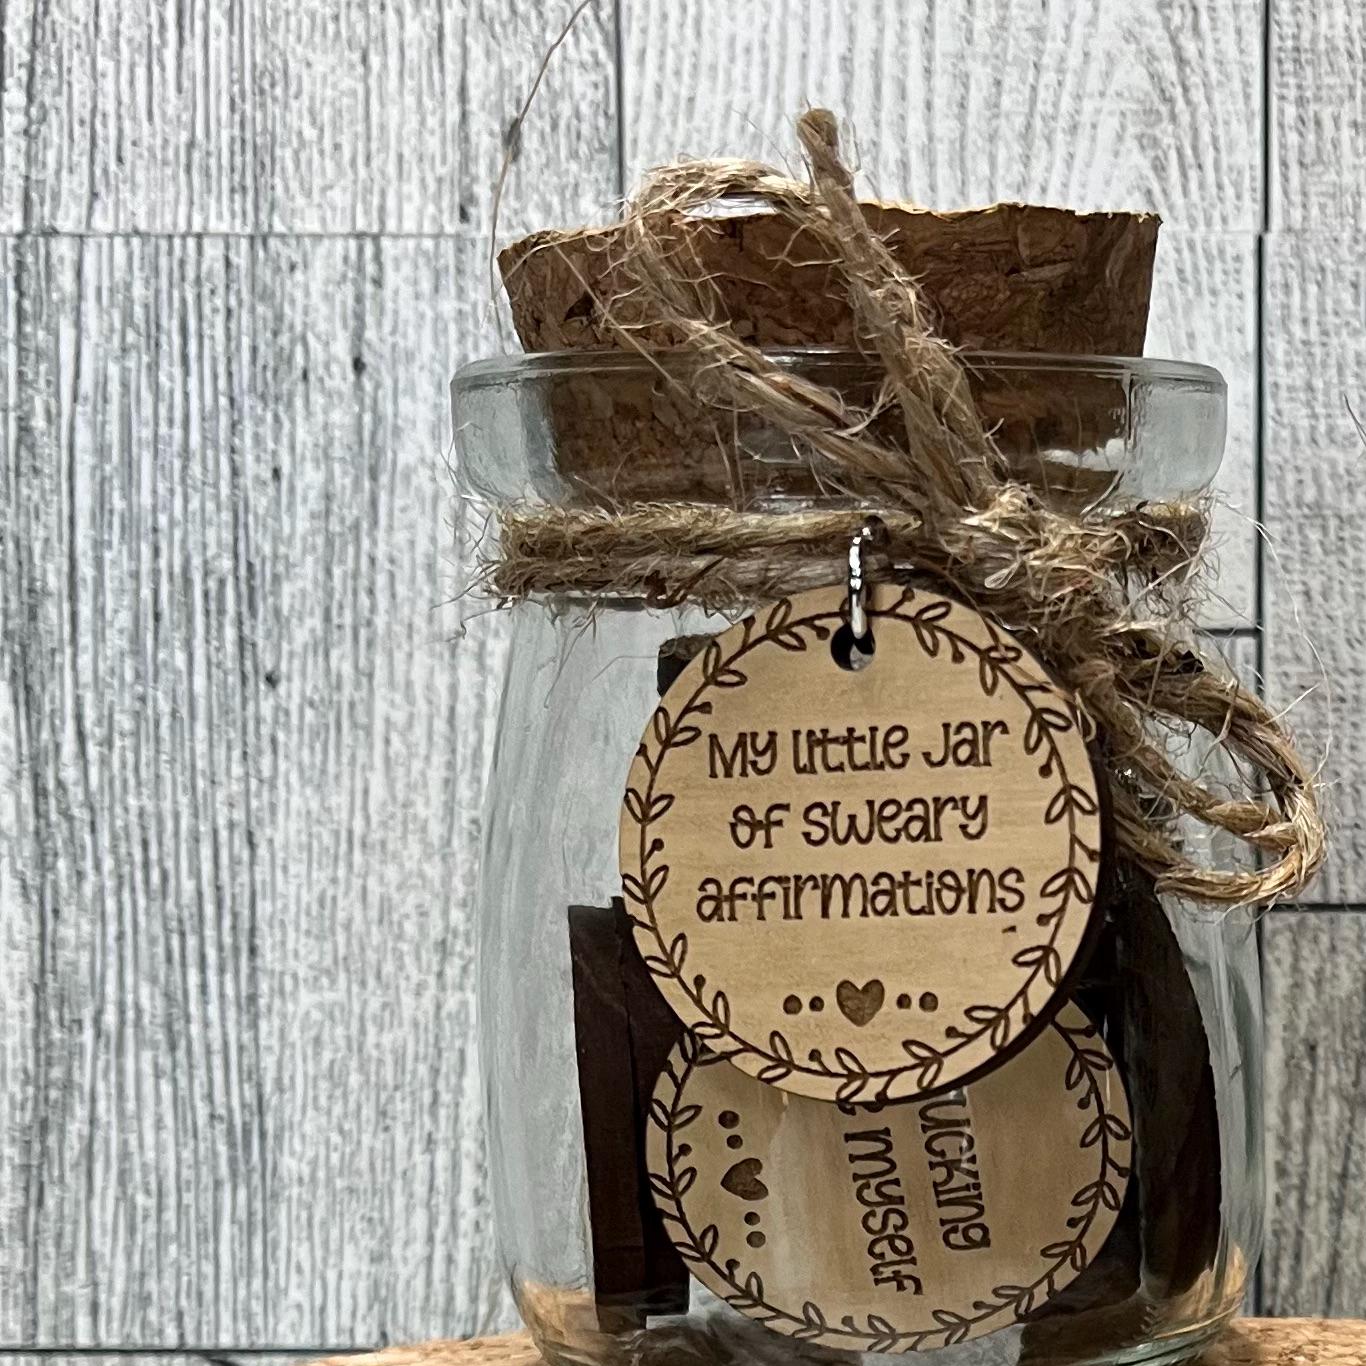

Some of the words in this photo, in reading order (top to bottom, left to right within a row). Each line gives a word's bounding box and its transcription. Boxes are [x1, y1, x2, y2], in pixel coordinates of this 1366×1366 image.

[708, 731, 777, 778] My
[729, 803, 791, 848] of
[802, 794, 988, 846] sweary
[696, 867, 1025, 922] affirmations
[918, 1098, 991, 1251] ucking
[843, 1126, 924, 1296] myself
